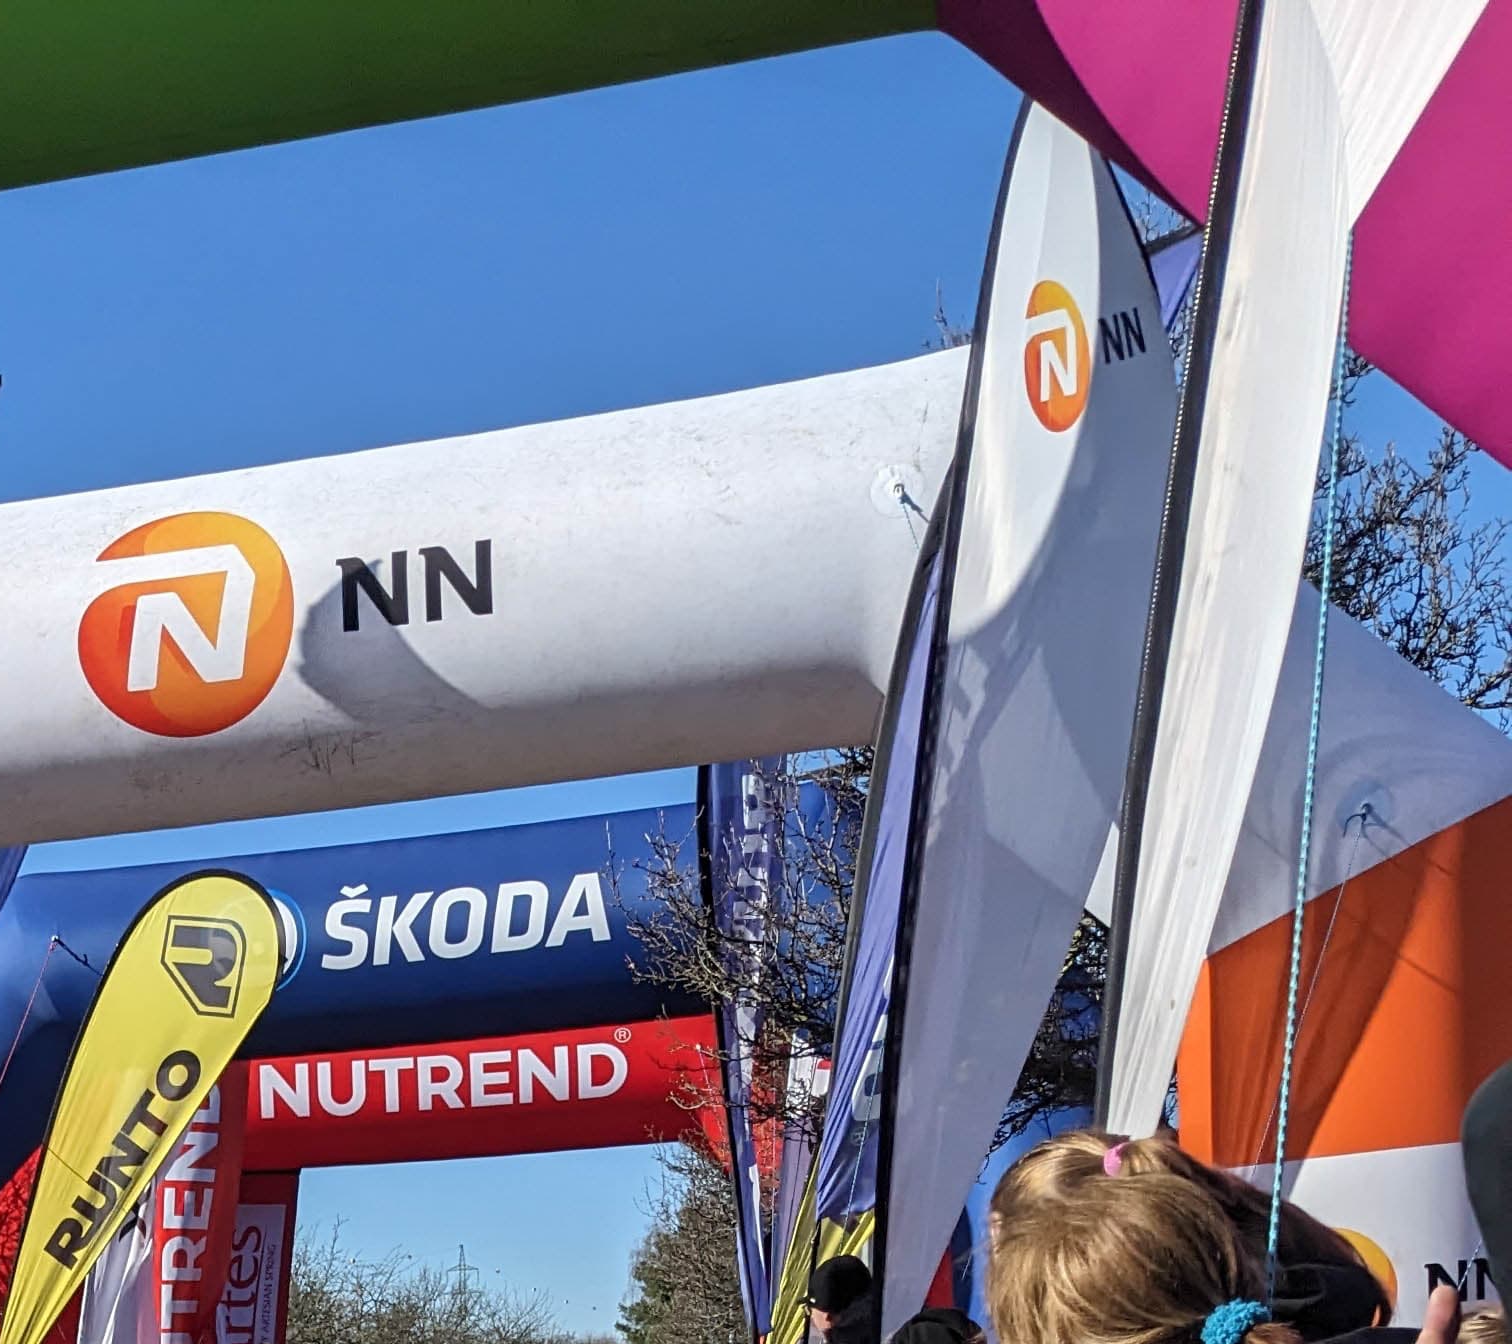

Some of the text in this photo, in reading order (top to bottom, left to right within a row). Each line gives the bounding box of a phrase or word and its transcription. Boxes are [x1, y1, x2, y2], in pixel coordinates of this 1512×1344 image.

[1098, 307, 1146, 364] NN
[336, 539, 493, 632] NN
[322, 872, 612, 970] ŠKODA
[258, 1042, 629, 1119] NUTREND
[45, 1050, 201, 1270] RUNTO
